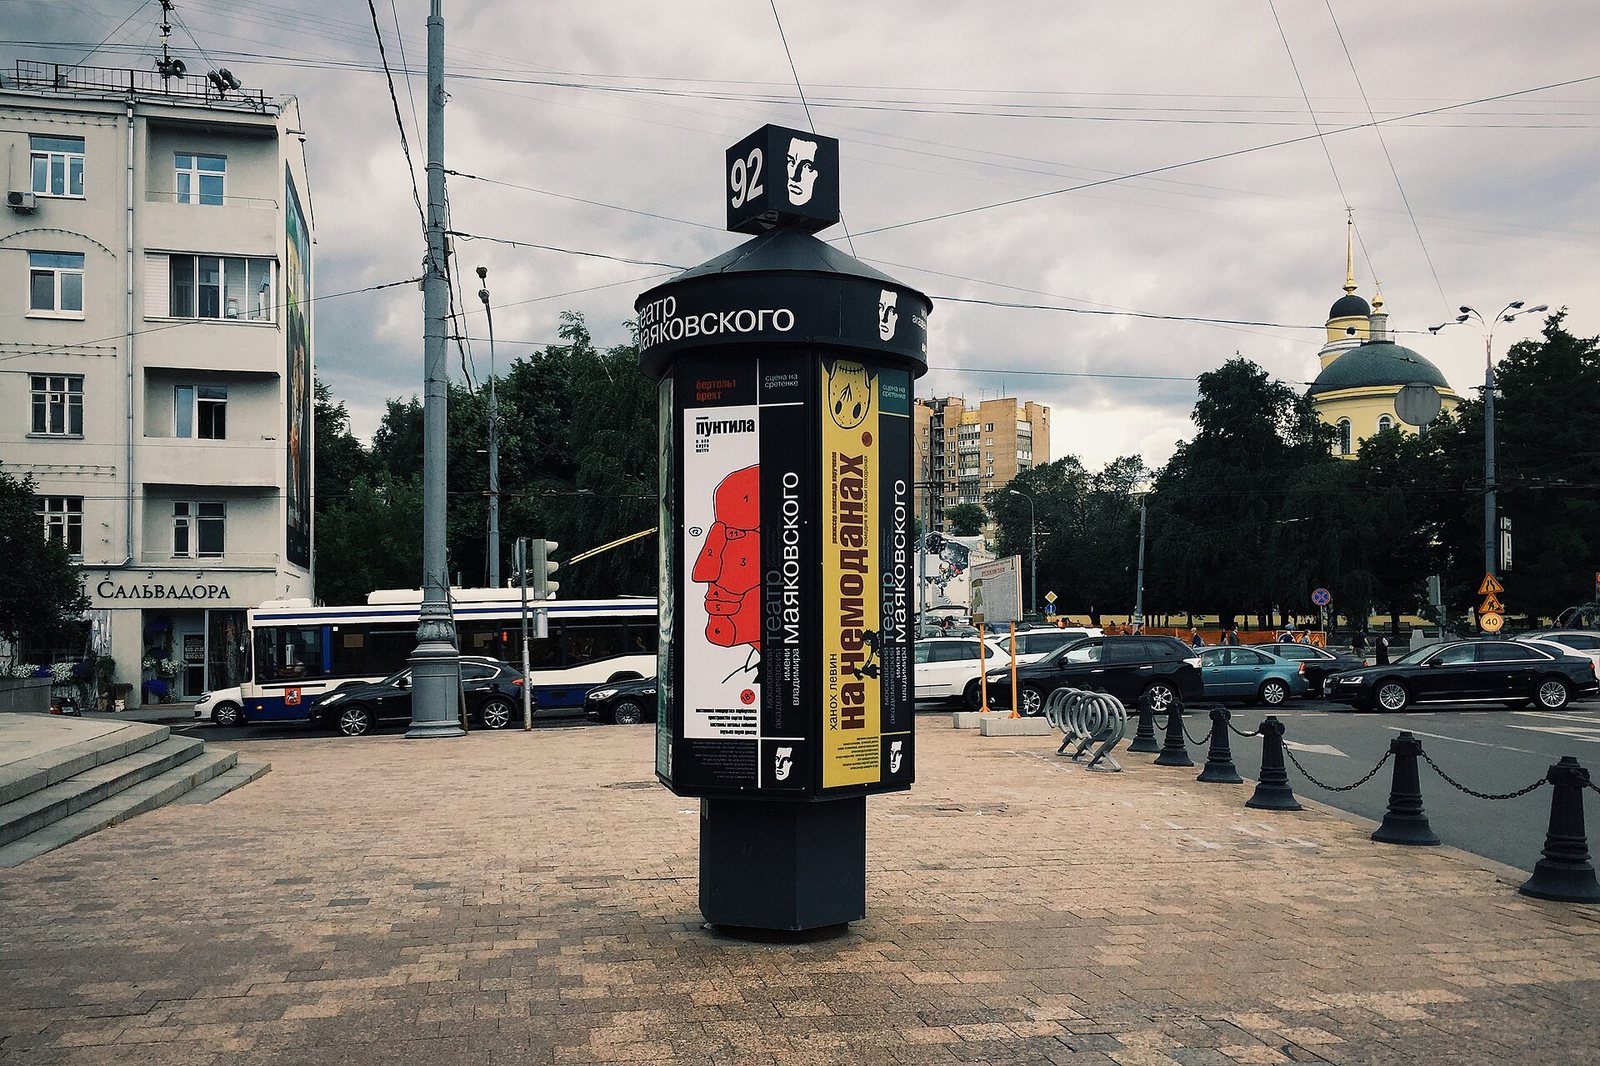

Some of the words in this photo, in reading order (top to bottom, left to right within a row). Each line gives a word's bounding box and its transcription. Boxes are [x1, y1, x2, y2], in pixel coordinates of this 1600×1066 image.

[731, 147, 763, 209] 92
[639, 296, 677, 329] еатр
[696, 380, 737, 390] бертольт
[696, 391, 722, 402] брехт
[765, 374, 788, 382] сцена
[765, 380, 799, 389] сретенке
[696, 419, 755, 437] пунтила
[707, 548, 713, 556] 2
[740, 557, 747, 567] 3
[782, 472, 800, 644] маяковского
[840, 452, 869, 676] чемоданах
[895, 480, 906, 643] маяковского
[766, 570, 785, 645] театр
[883, 572, 896, 644] театр
[783, 648, 791, 681] имени
[792, 648, 801, 706] владимира
[829, 653, 838, 691] левин
[829, 694, 838, 731] ханох
[840, 683, 865, 730] на
